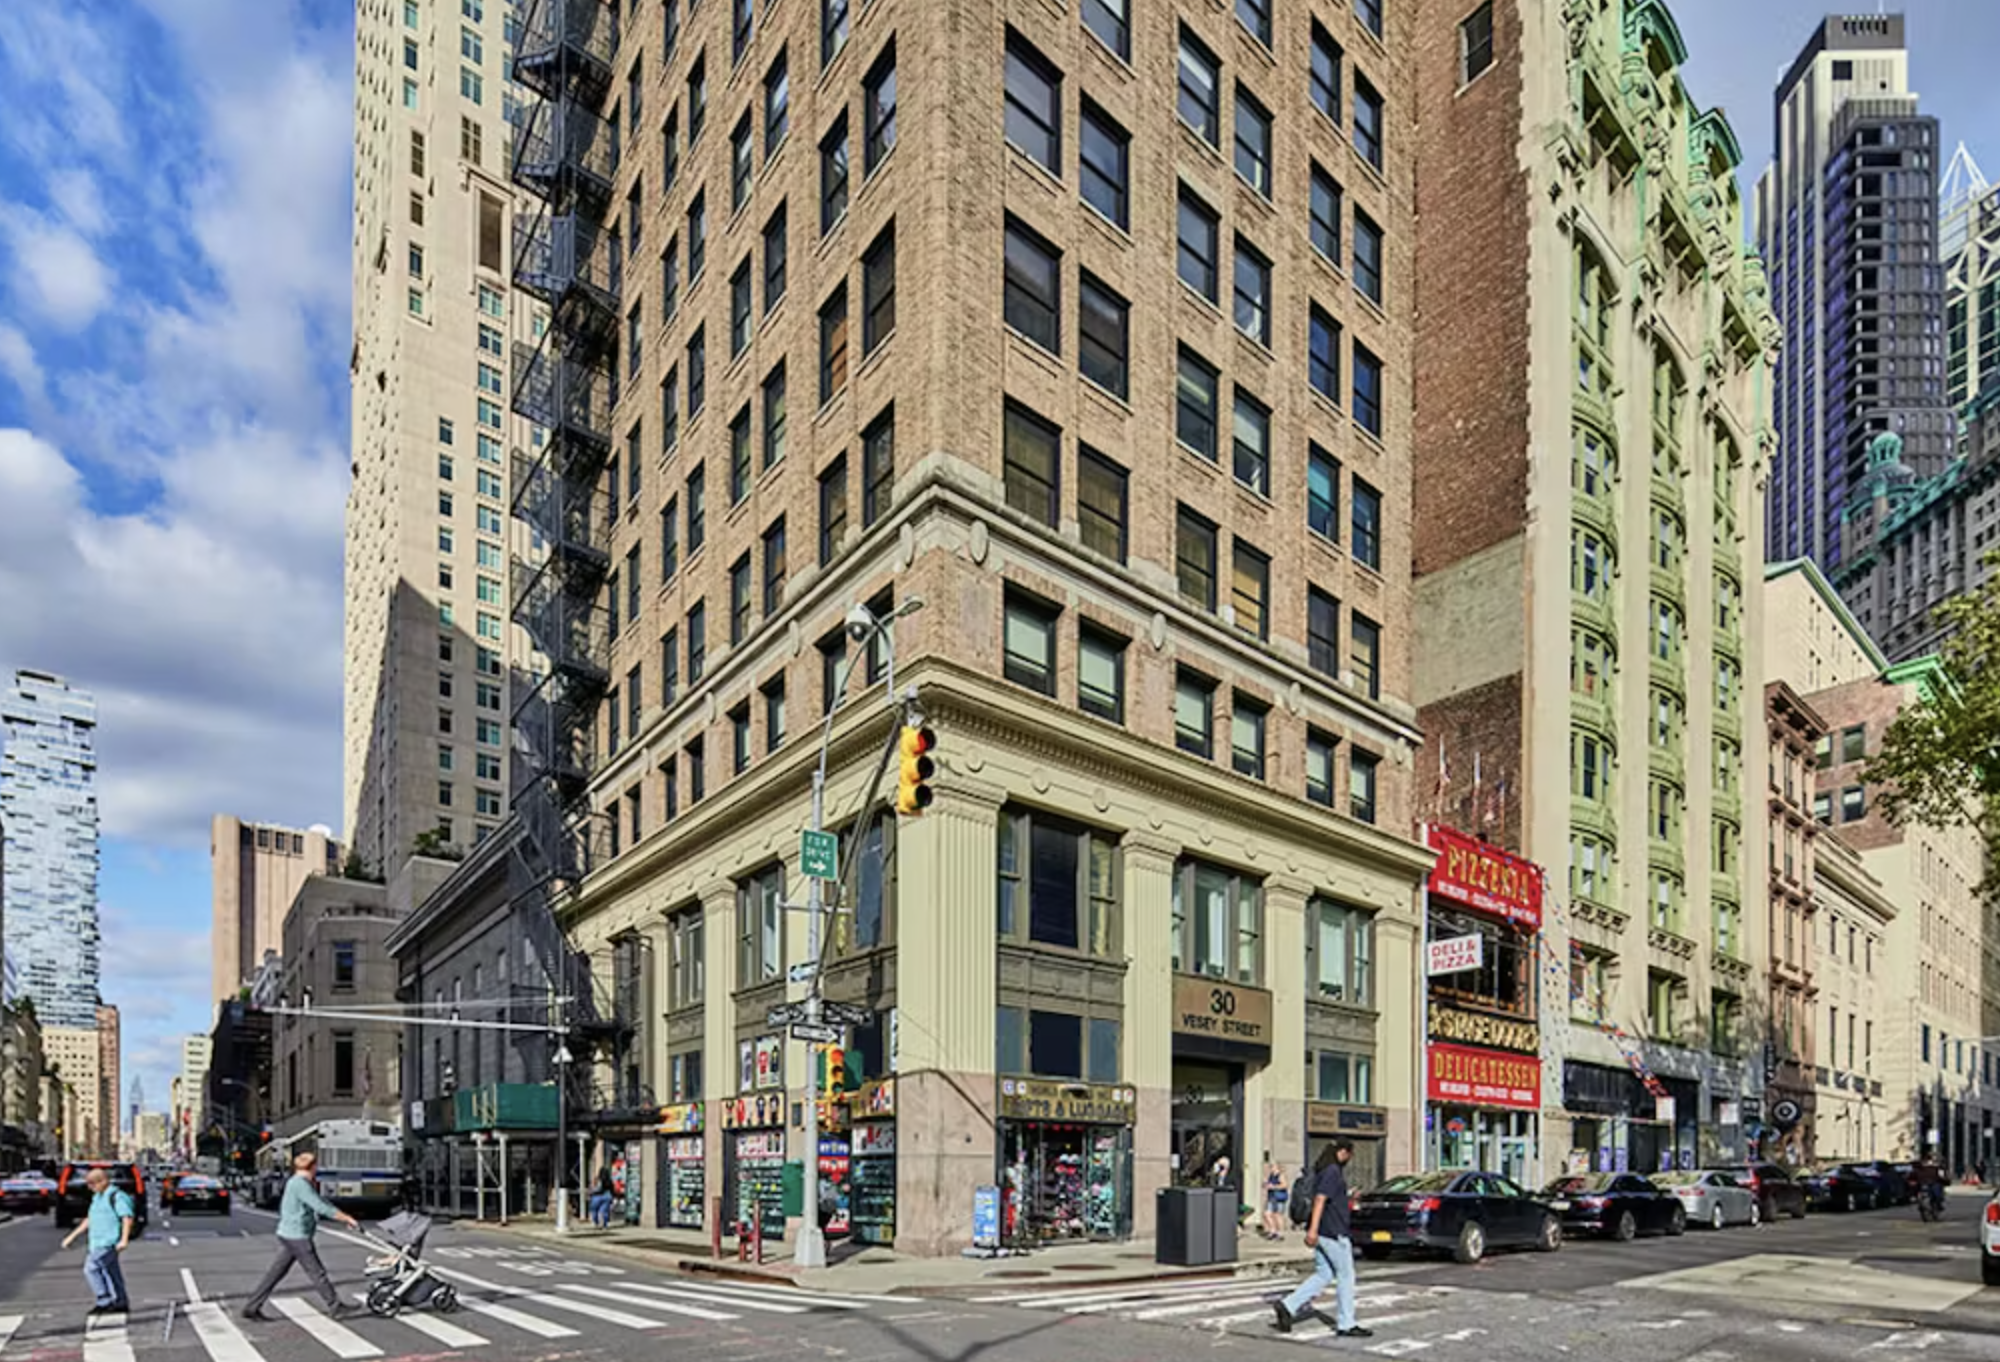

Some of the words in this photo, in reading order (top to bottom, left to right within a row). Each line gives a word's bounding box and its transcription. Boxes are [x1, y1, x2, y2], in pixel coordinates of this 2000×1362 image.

[1448, 844, 1529, 906] PIZZERIA
[1433, 954, 1476, 971] PIZZA
[1211, 988, 1236, 1016] 30
[1182, 1013, 1217, 1031] VESEY
[1221, 1019, 1261, 1037] STREET
[1435, 1051, 1537, 1089] DELICATESSEN
